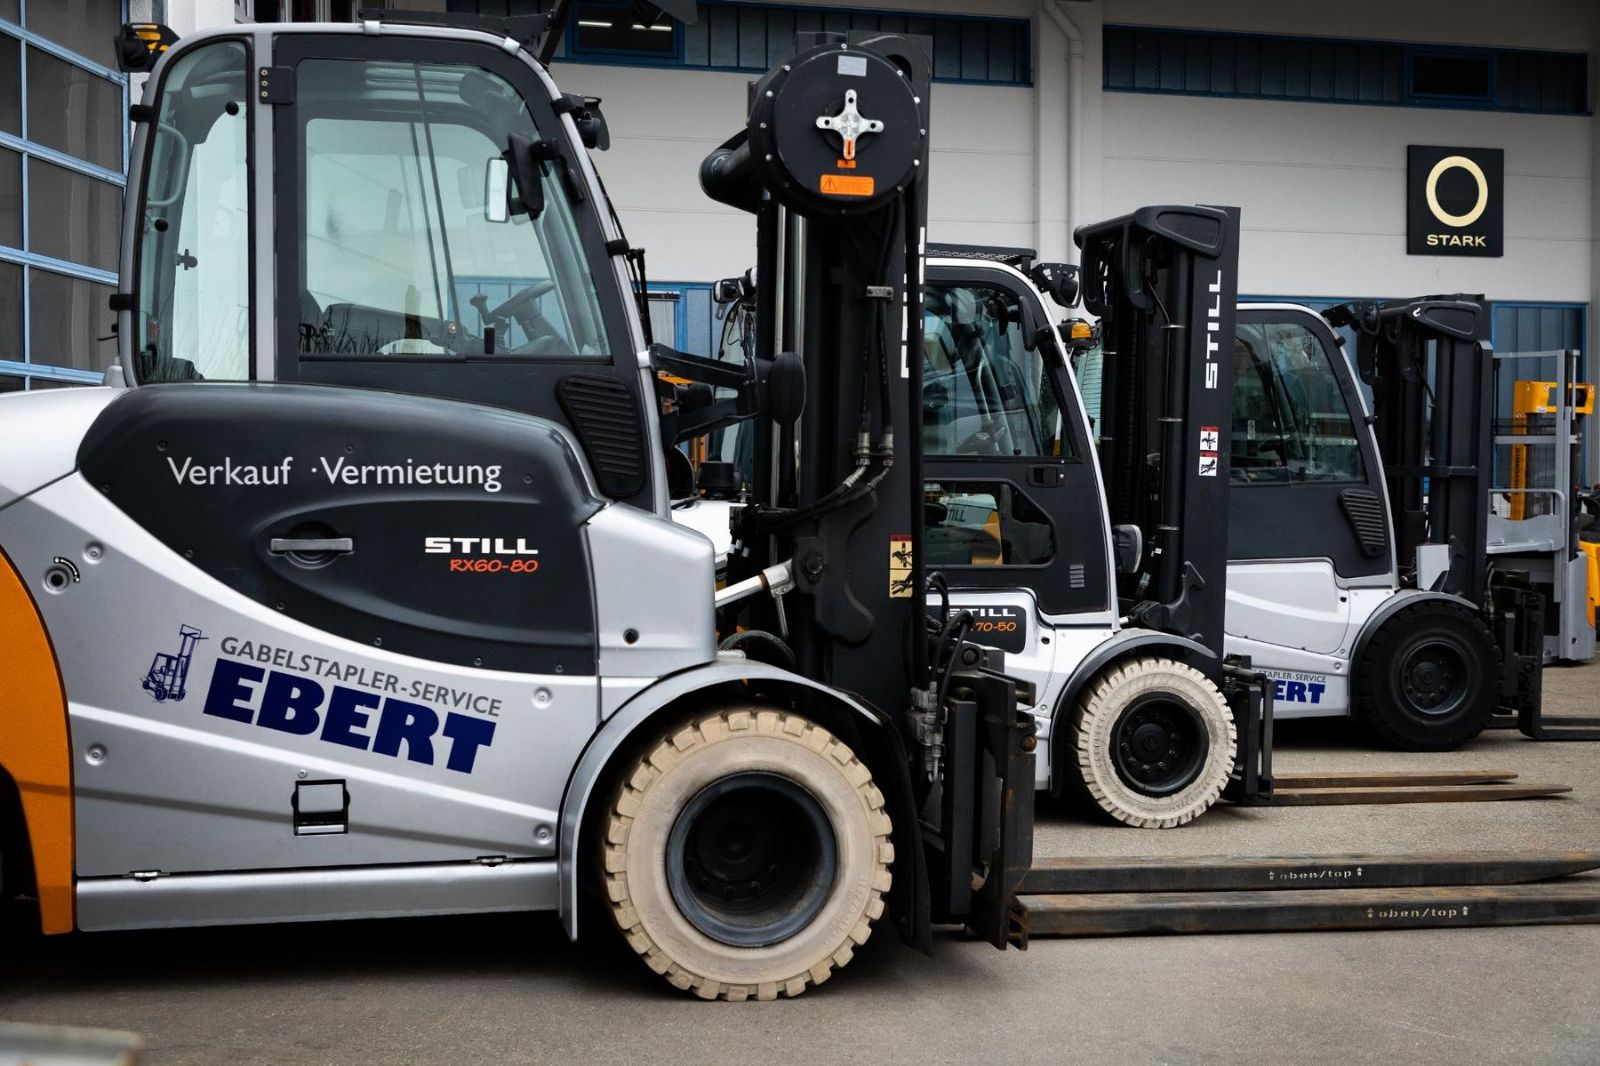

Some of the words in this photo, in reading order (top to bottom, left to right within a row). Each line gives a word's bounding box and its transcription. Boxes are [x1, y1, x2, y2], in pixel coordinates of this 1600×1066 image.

[1426, 234, 1487, 247] STARK
[1205, 269, 1222, 389] STILL
[167, 456, 294, 485] Verkauf
[425, 537, 539, 554] STILL
[450, 558, 539, 573] RX60-80
[971, 621, 1017, 632] 70-50
[220, 636, 503, 718] GABELSTAPLER-SERVICE
[1272, 680, 1326, 704] ERT
[202, 657, 497, 774] EBERT
[1280, 869, 1352, 880] oben/top
[1379, 907, 1457, 919] oben/top
